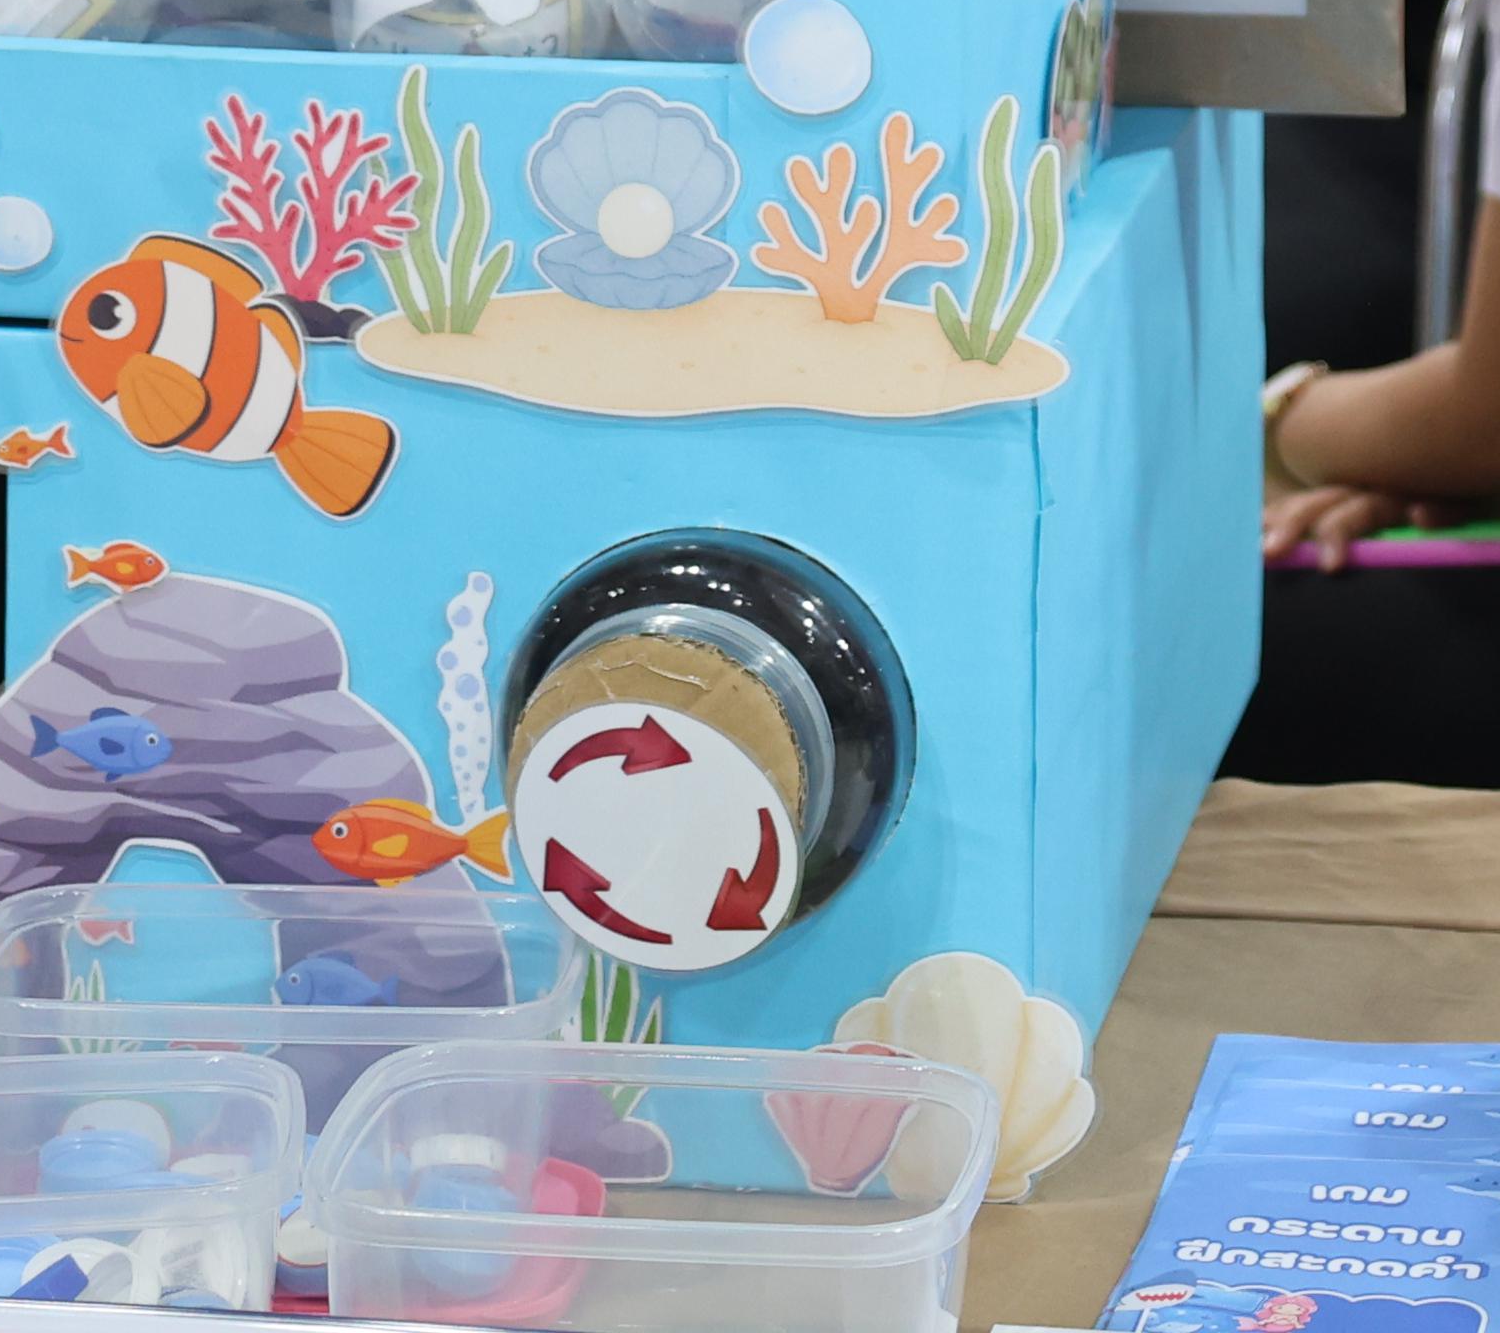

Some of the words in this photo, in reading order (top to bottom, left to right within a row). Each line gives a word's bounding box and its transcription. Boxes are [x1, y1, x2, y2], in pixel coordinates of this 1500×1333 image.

[1353, 1110, 1448, 1130] เกม
[1308, 1183, 1410, 1206] เกม
[1227, 1214, 1465, 1247] กระดาน
[1175, 1239, 1489, 1281] ฝึกสะกดคำ
